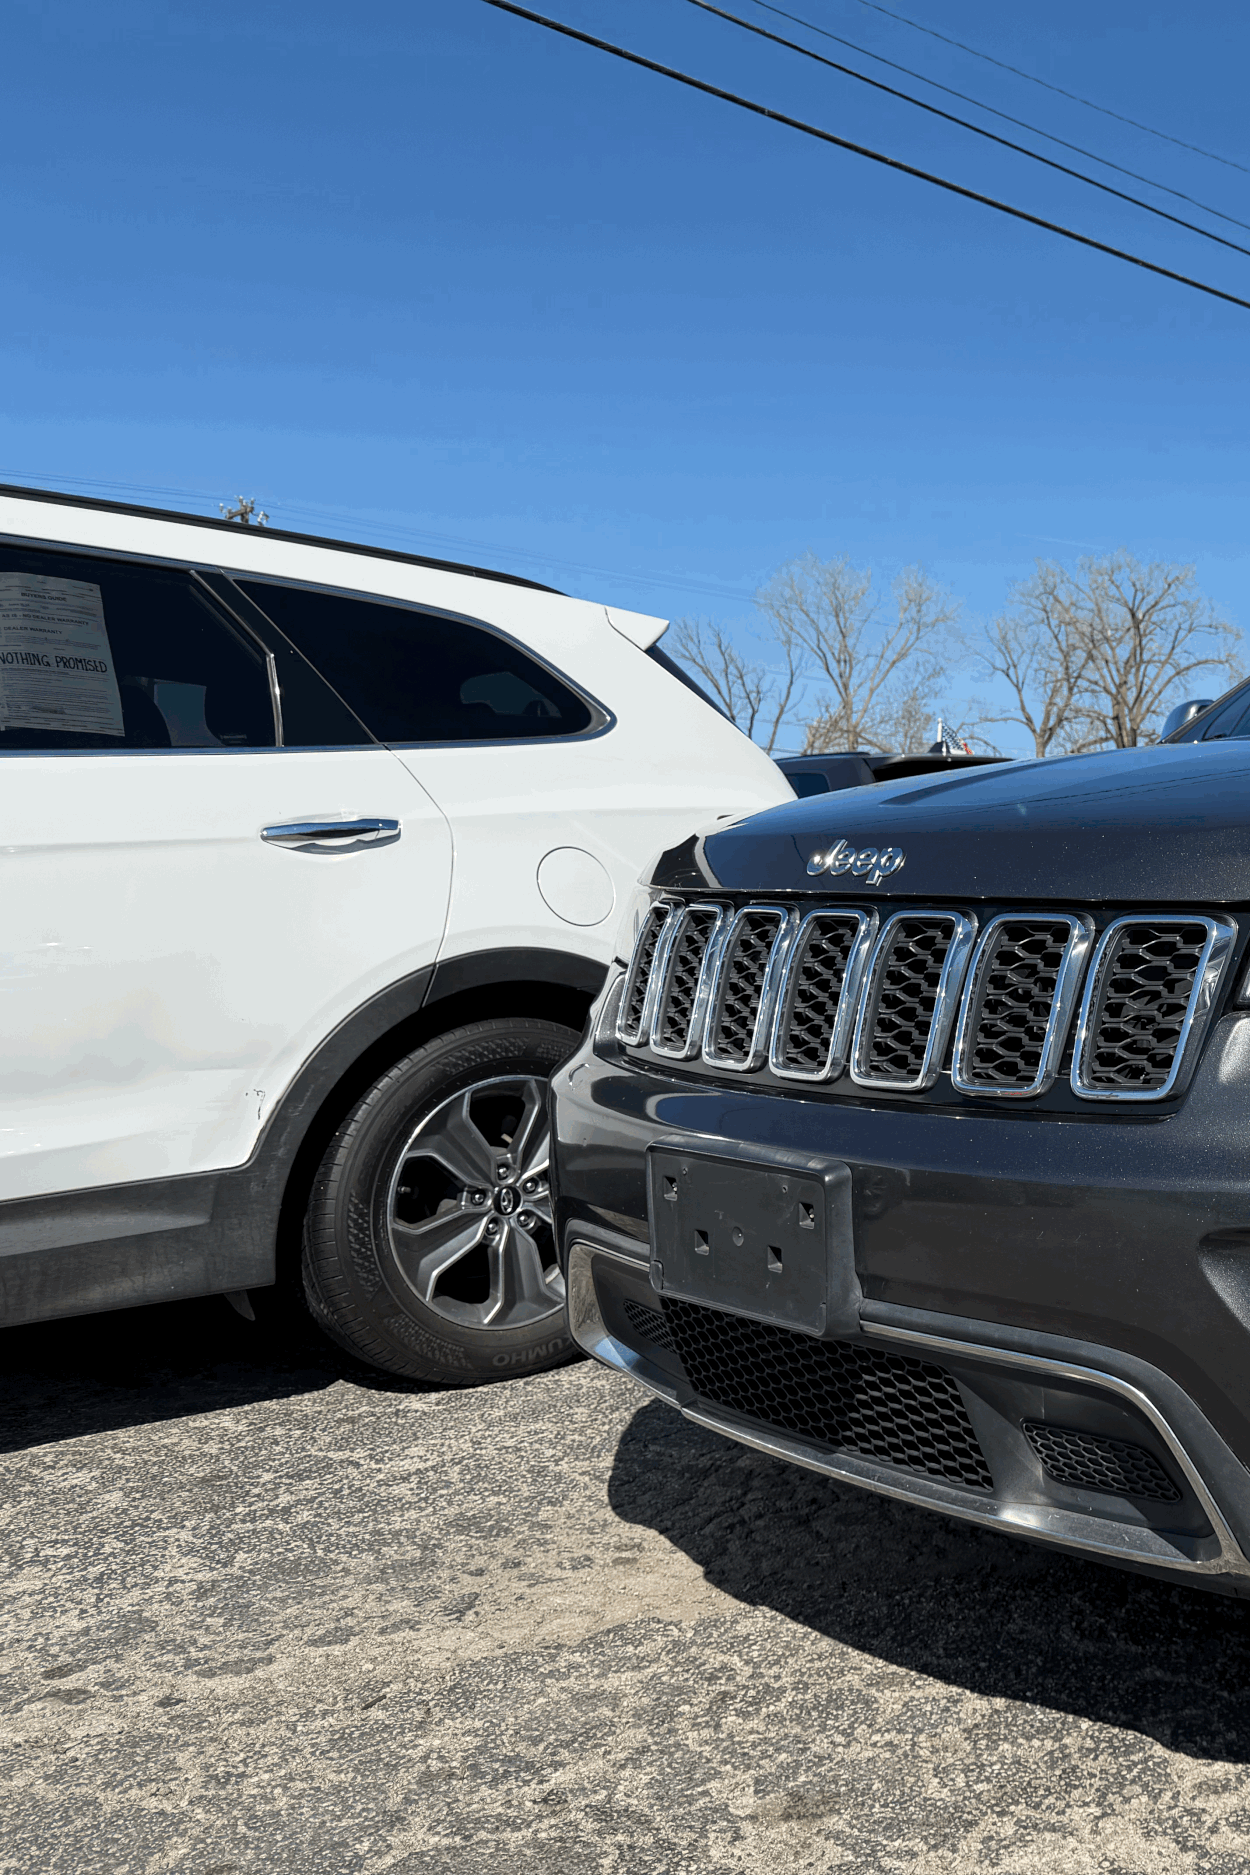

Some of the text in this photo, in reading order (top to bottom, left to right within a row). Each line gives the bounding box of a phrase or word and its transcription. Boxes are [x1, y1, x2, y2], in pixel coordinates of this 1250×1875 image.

[21, 592, 47, 600] BUYERS
[0, 651, 108, 673] NOTHING PROMISED
[806, 838, 907, 886] Jeep
